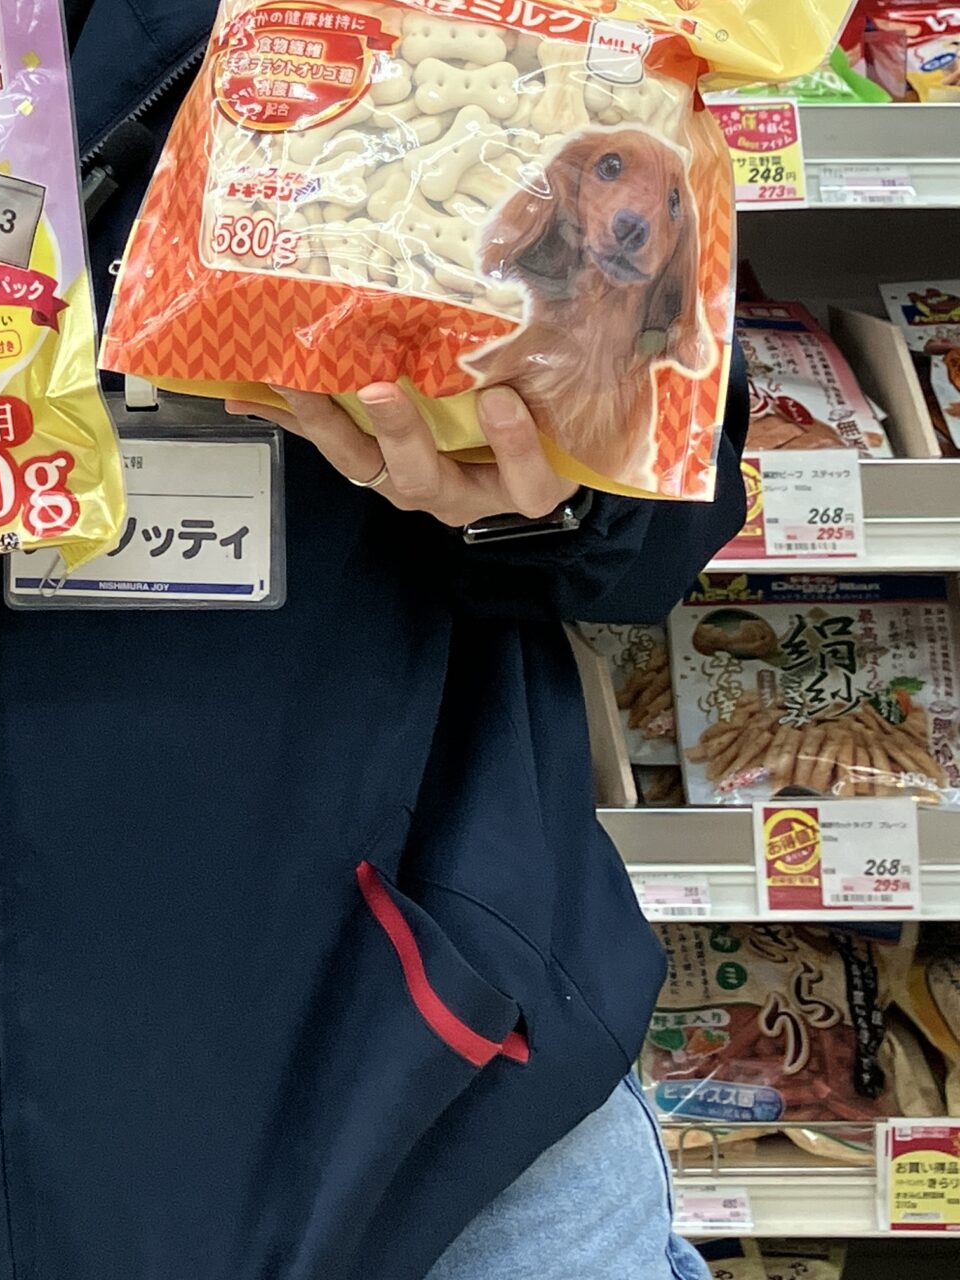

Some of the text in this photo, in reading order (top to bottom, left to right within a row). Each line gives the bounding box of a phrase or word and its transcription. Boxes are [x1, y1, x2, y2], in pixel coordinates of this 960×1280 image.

[257, 36, 324, 59] 食物繊維
[598, 35, 643, 55] MILK
[266, 102, 290, 117] 配合
[748, 166, 797, 183] 248円
[758, 186, 797, 198] 273円
[212, 216, 301, 270] 580g
[808, 507, 854, 524] 268円
[98, 581, 170, 592] NISHIMURA JOY
